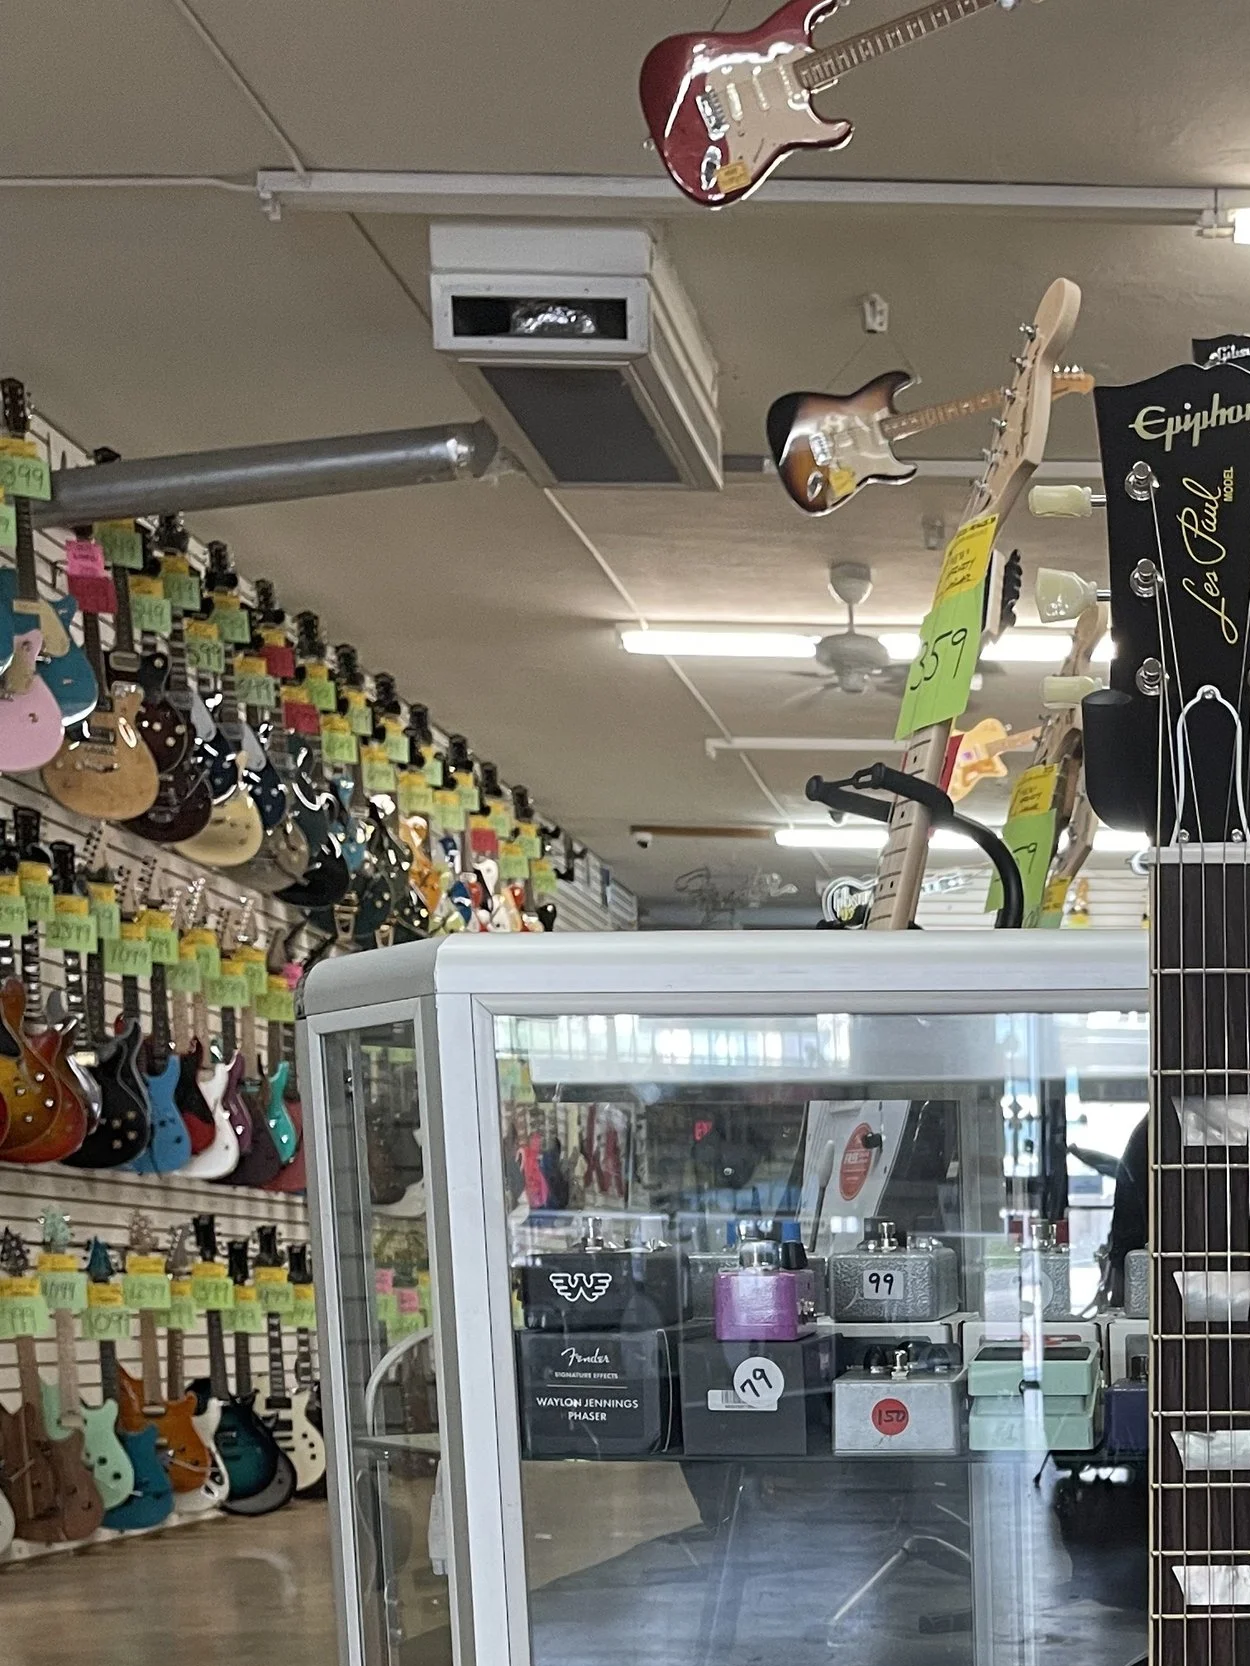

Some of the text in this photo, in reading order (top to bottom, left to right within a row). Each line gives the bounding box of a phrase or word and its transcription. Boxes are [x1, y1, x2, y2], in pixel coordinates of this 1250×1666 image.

[1223, 466, 1234, 502] MODEL
[1175, 477, 1239, 644] Les Paul
[909, 627, 968, 691] 359
[867, 1272, 895, 1296] 99
[560, 1346, 611, 1367] Fender
[554, 1371, 619, 1380] SIGNATURE EFFECTS
[739, 1367, 774, 1399] 79
[536, 1396, 640, 1409] WAYLON JENNINGS
[567, 1410, 608, 1421] PHASER
